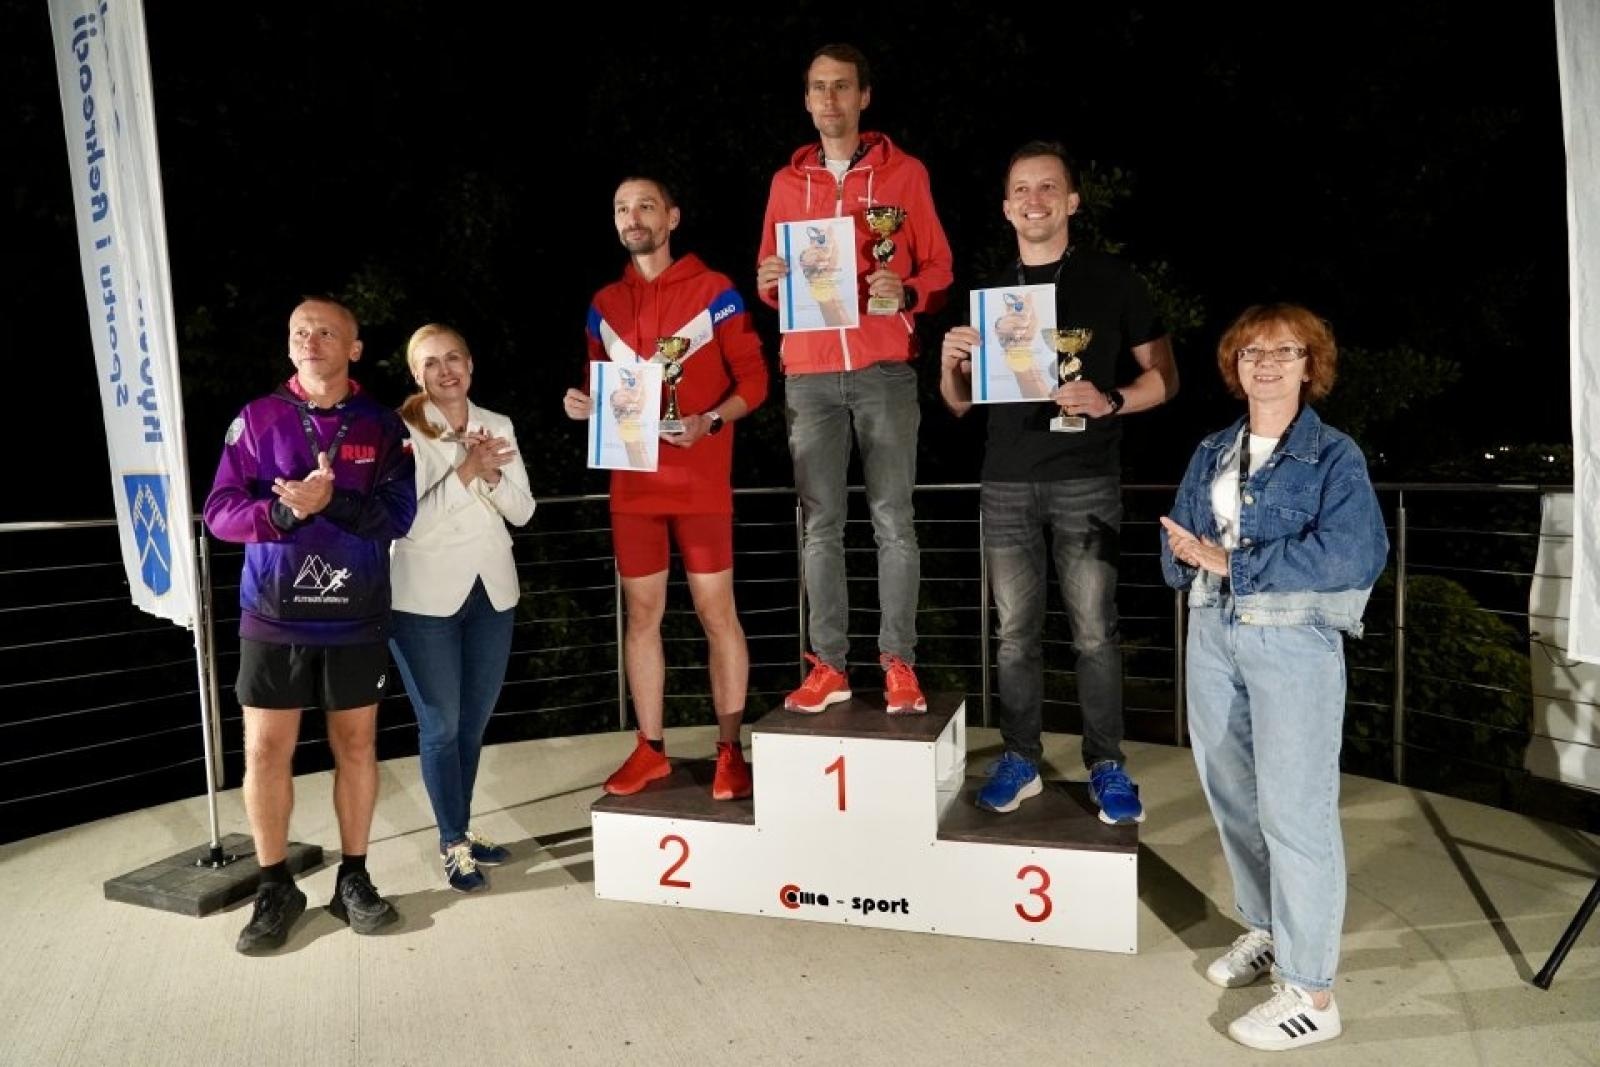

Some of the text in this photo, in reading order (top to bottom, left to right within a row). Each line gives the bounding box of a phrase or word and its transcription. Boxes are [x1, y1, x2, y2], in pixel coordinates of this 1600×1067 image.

[824, 755, 848, 813] 1
[659, 833, 691, 889] 2
[851, 896, 909, 915] sport
[1015, 864, 1054, 924] 3
